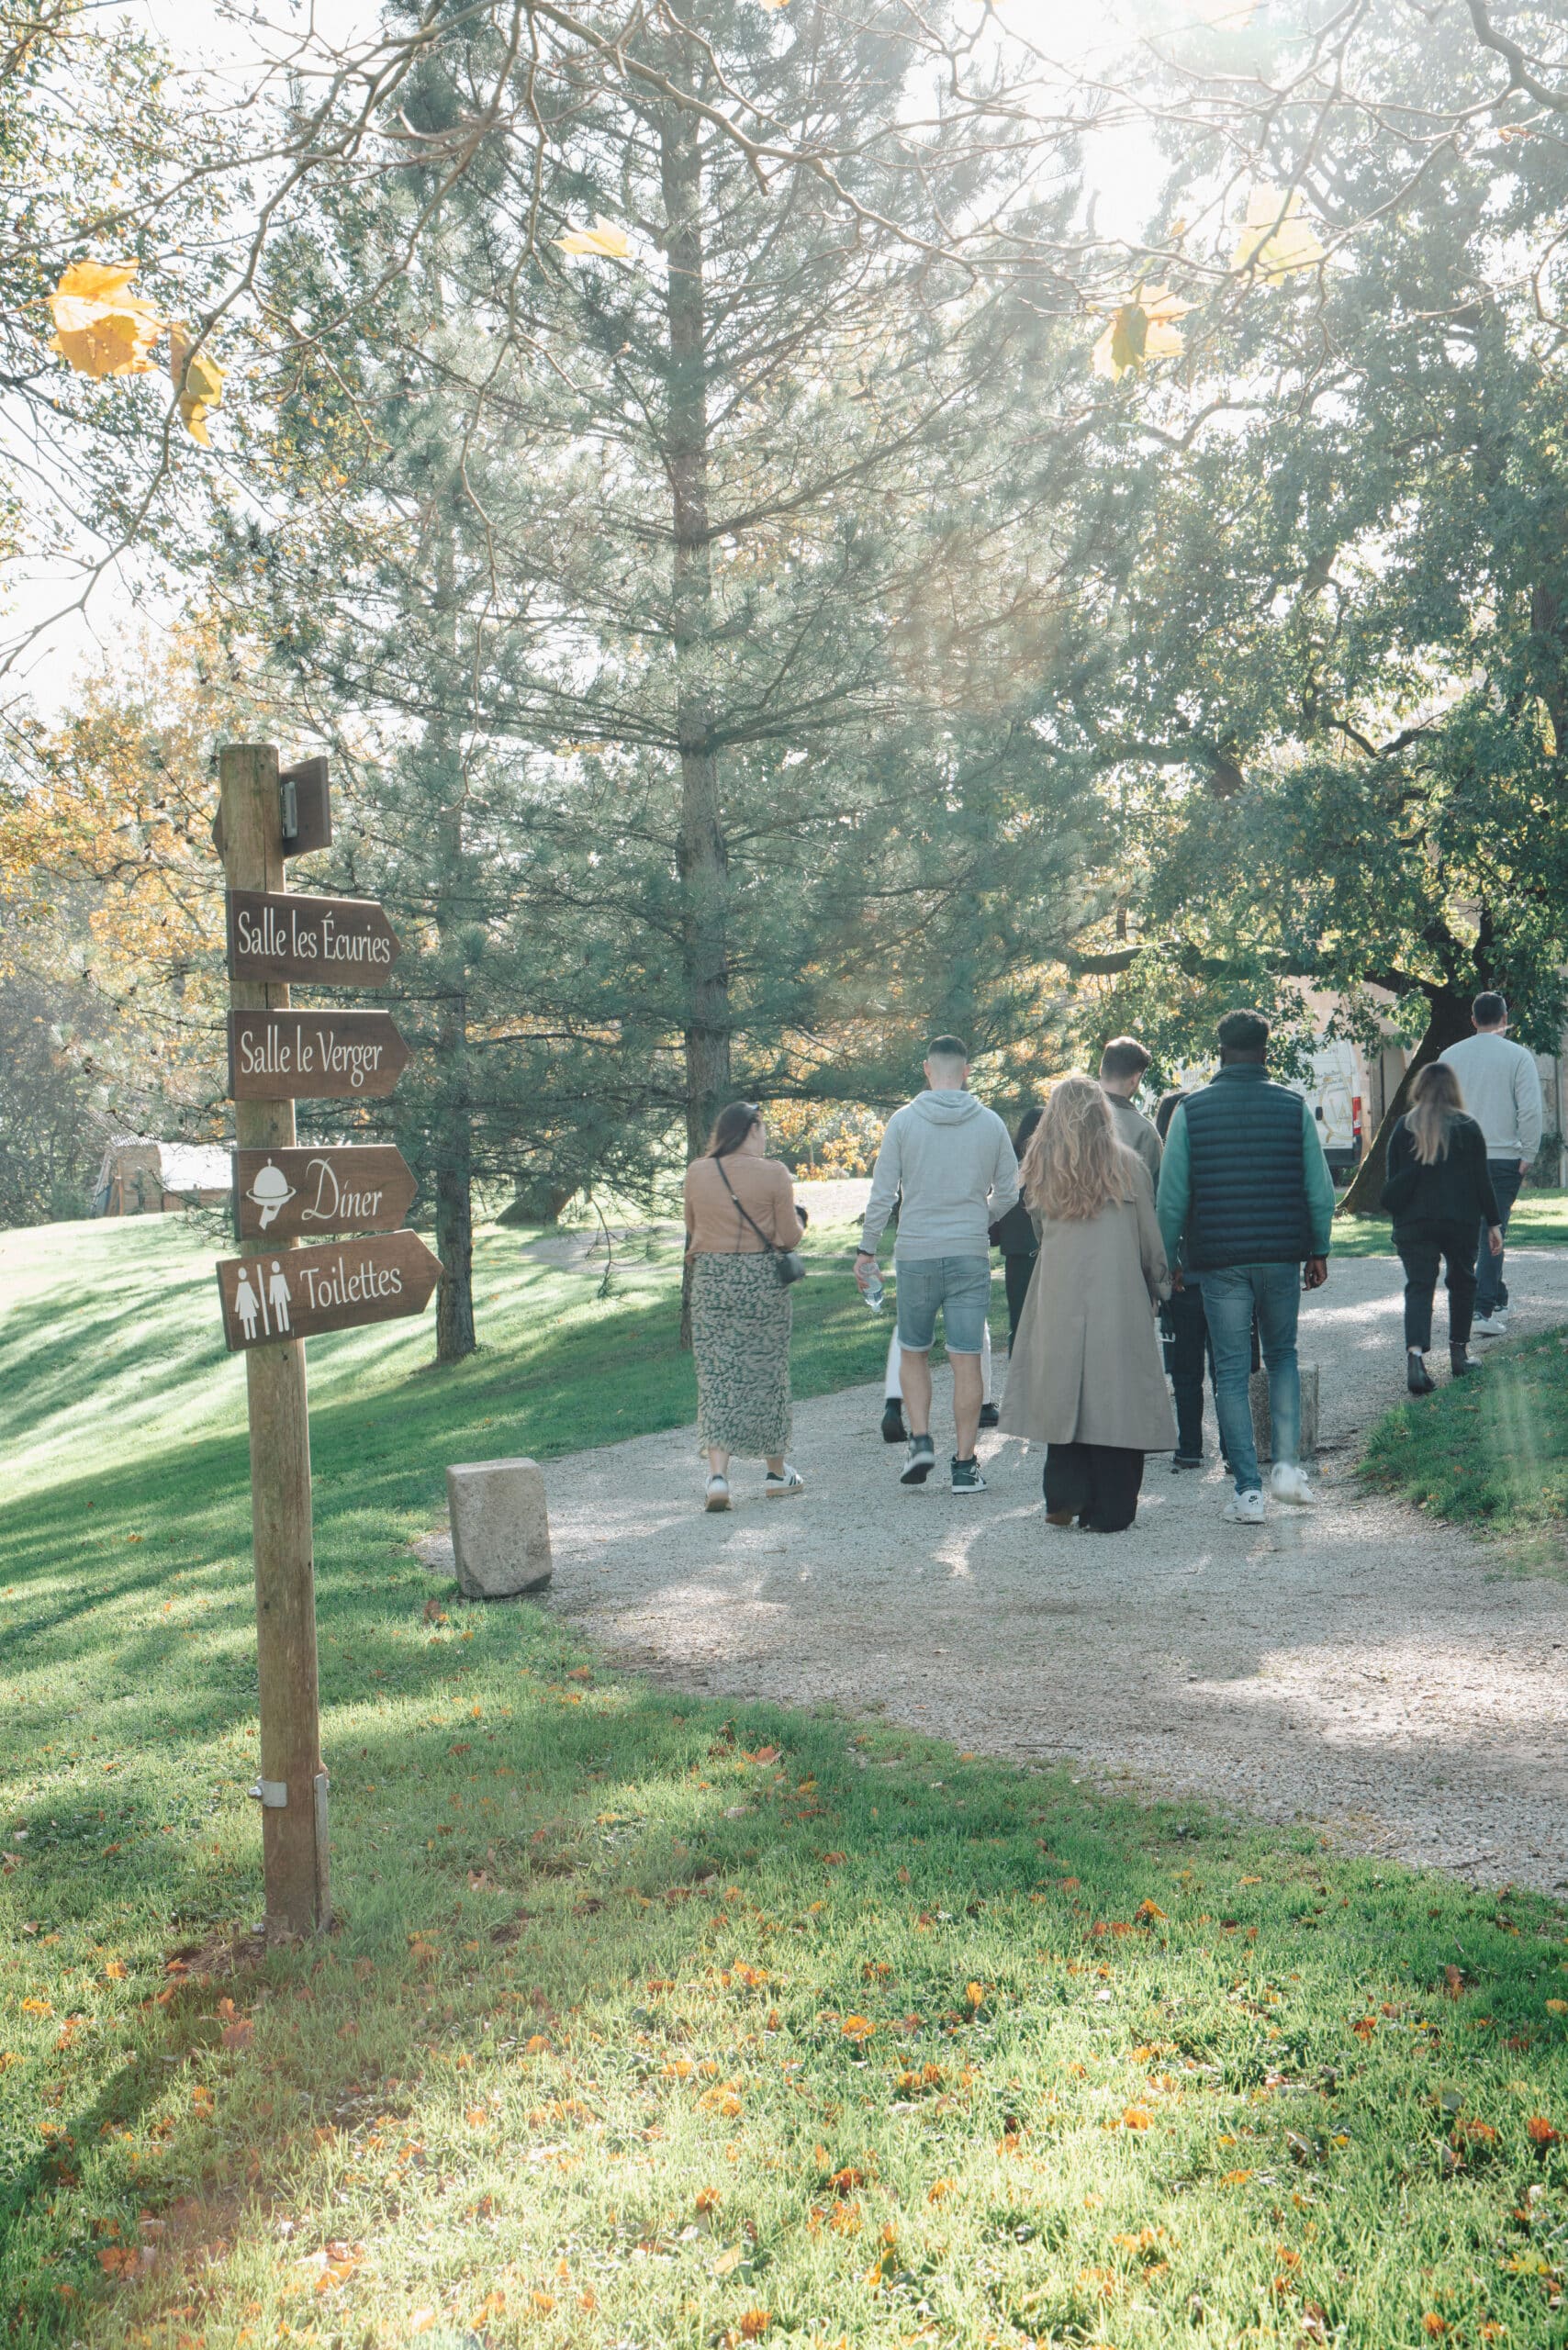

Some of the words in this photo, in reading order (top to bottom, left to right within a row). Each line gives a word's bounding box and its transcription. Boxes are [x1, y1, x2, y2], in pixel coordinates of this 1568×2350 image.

[238, 906, 286, 957] Salle
[292, 909, 318, 958] les
[320, 911, 390, 964] Écuries
[241, 1024, 291, 1074] Salle
[297, 1024, 313, 1073] le
[316, 1030, 383, 1088] Verger
[299, 1256, 403, 1309] Toilettes
